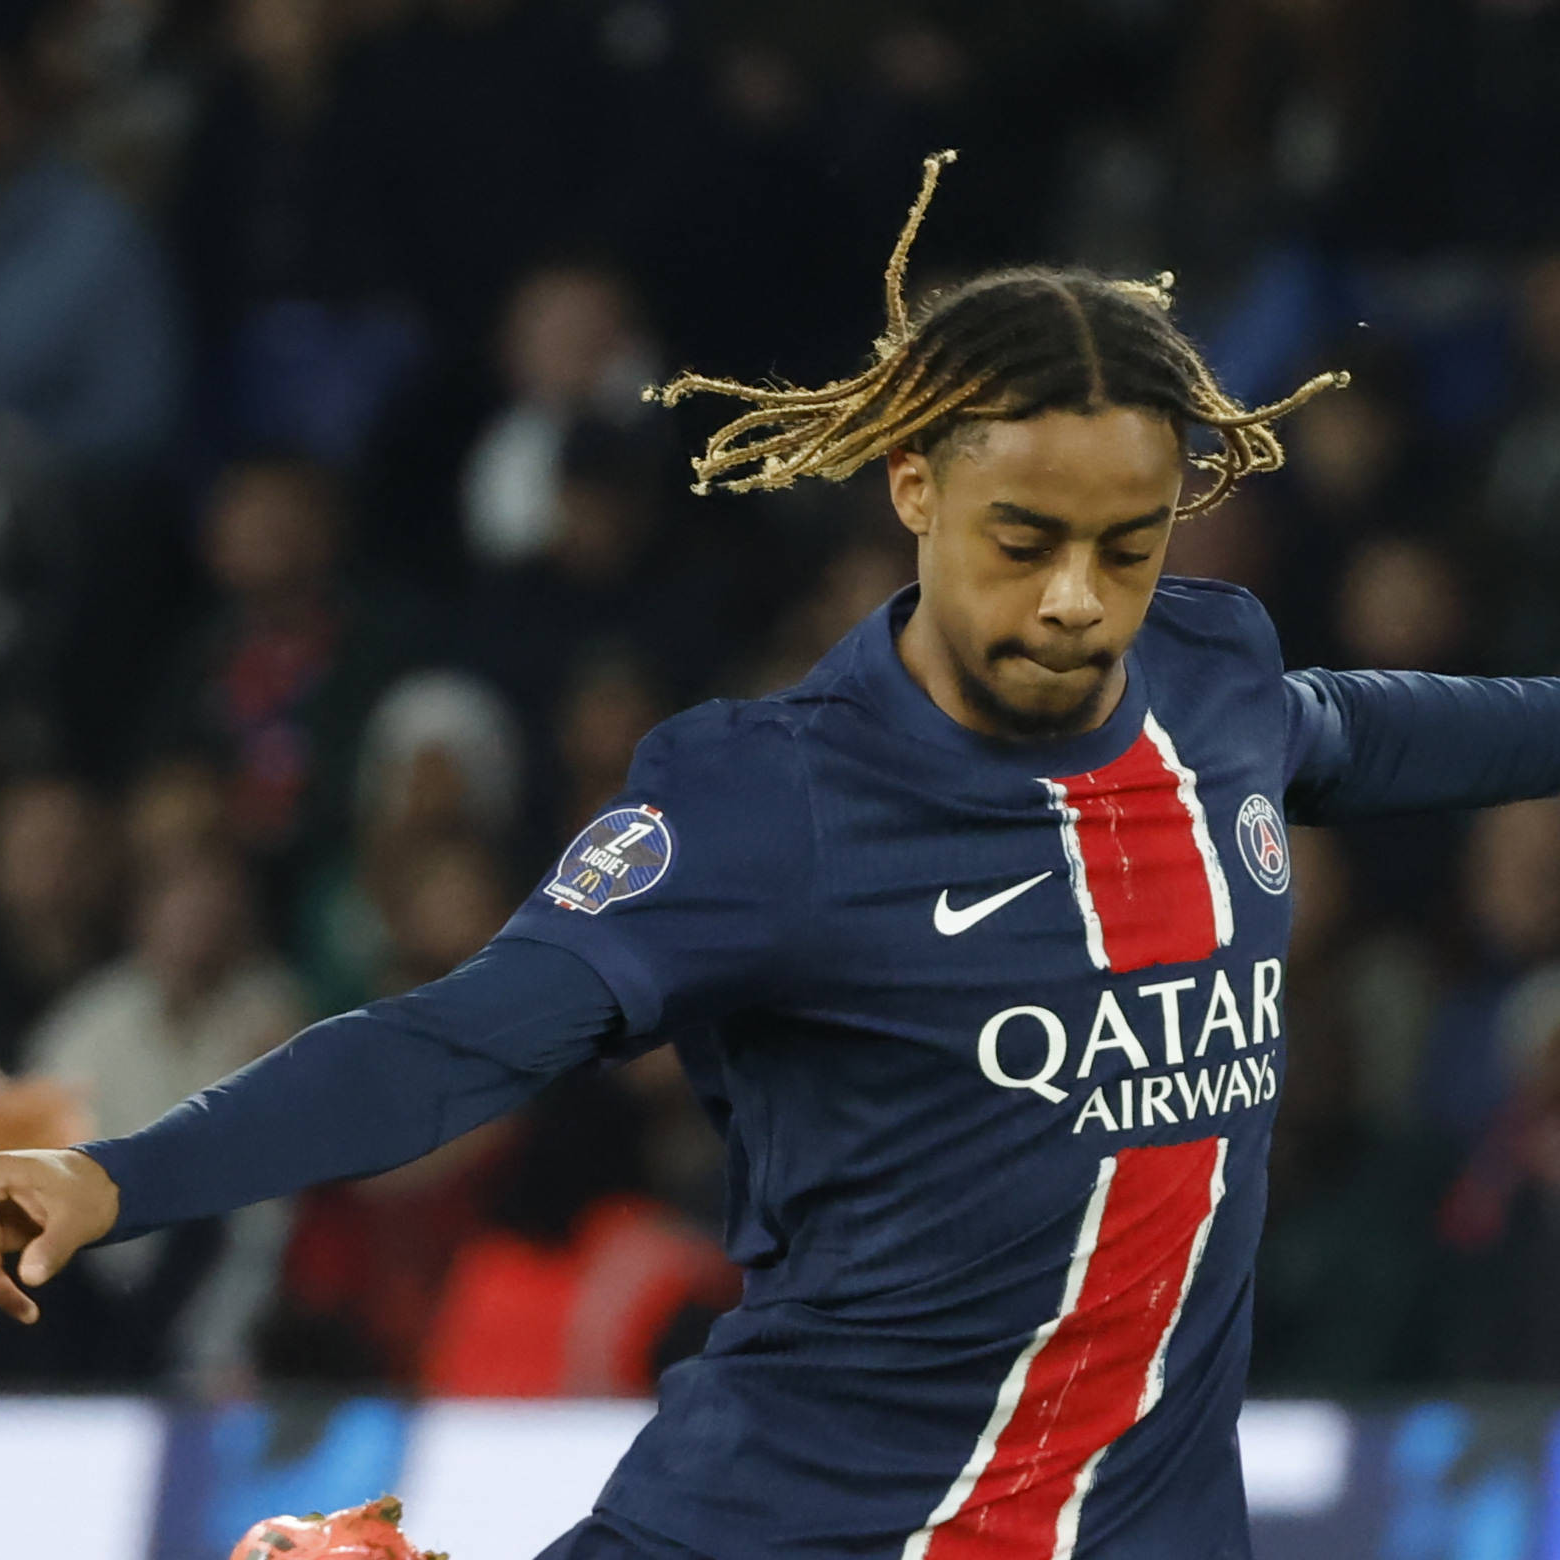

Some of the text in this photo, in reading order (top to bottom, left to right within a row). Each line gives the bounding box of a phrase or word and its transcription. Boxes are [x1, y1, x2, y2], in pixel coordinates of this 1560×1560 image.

[1241, 799, 1273, 827] PARIS
[579, 845, 631, 879] LIGUE 1
[977, 957, 1282, 1104] QATAR
[1072, 1048, 1277, 1134] AIRWAYS
